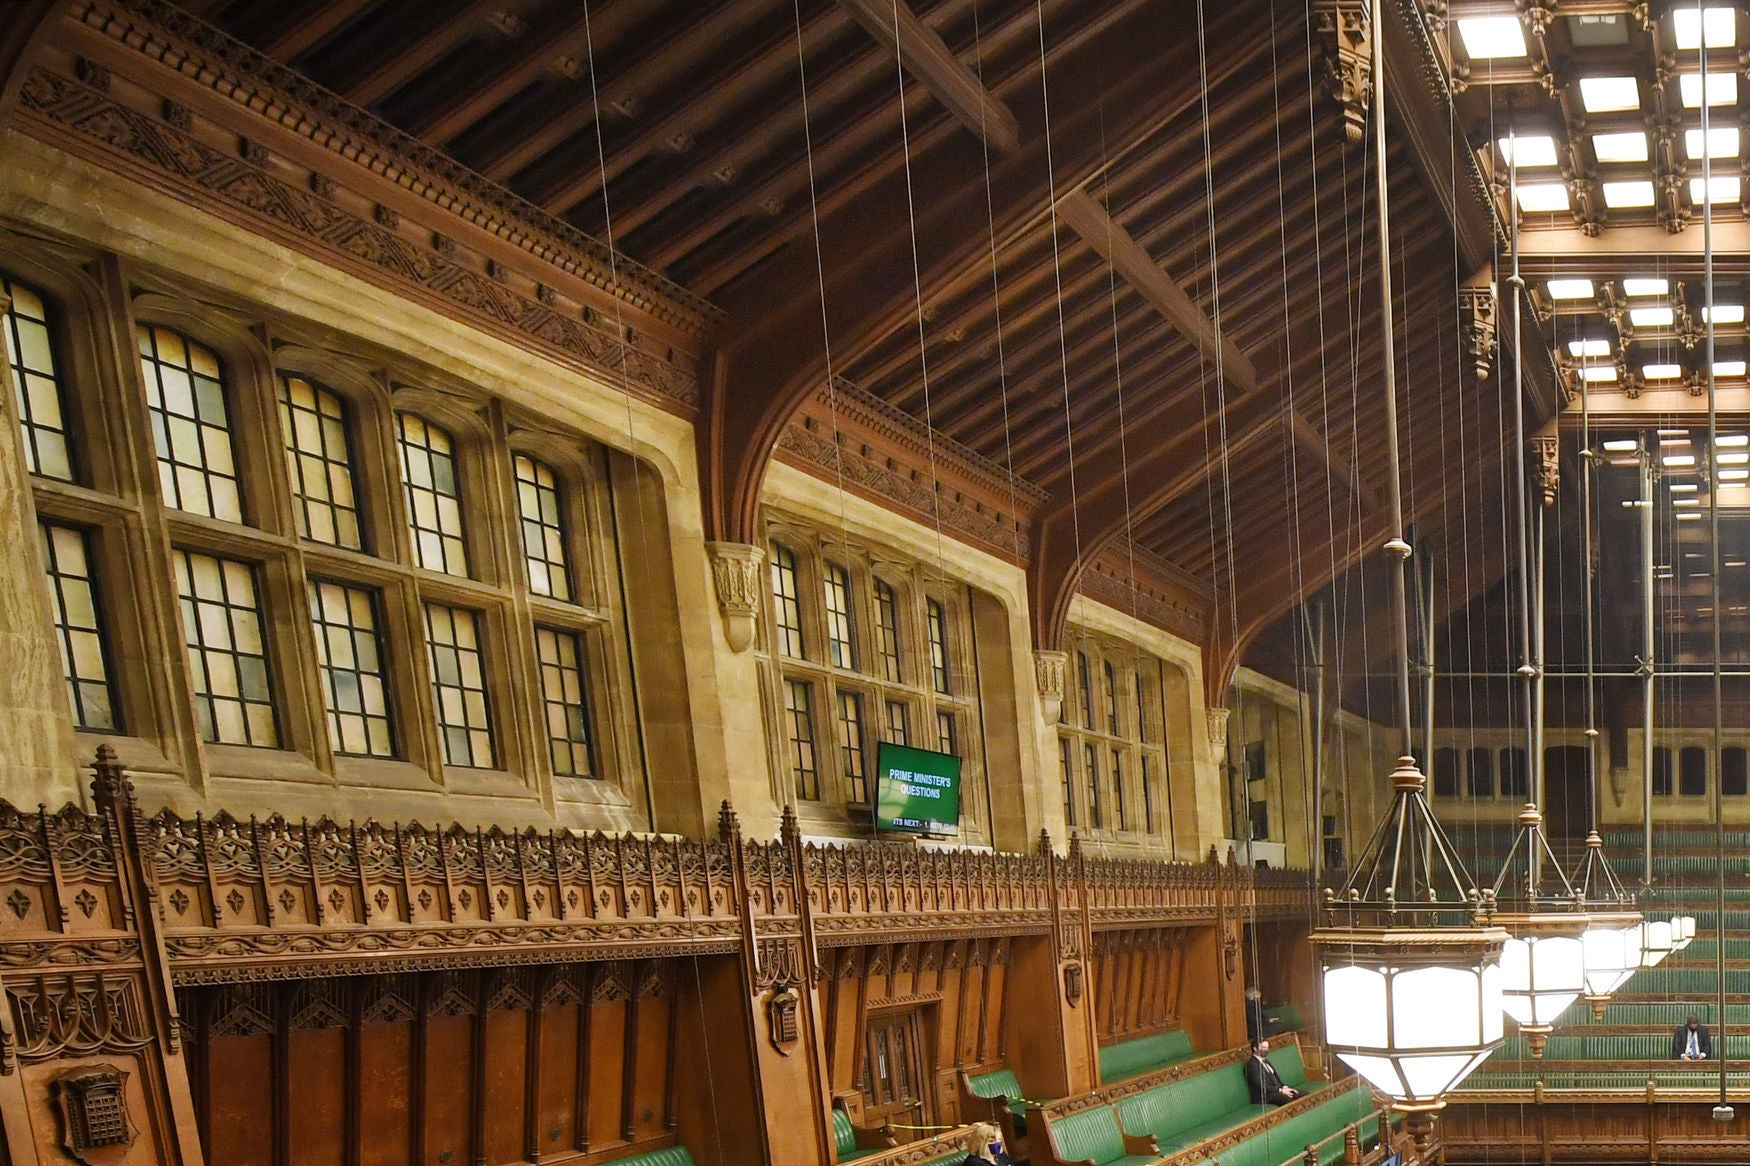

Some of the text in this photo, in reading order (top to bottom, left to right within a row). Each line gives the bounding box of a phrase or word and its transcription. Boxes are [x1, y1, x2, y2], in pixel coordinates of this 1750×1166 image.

[889, 769, 951, 788] PRIME MINISTER'S
[900, 784, 941, 799] QUESTIONS
